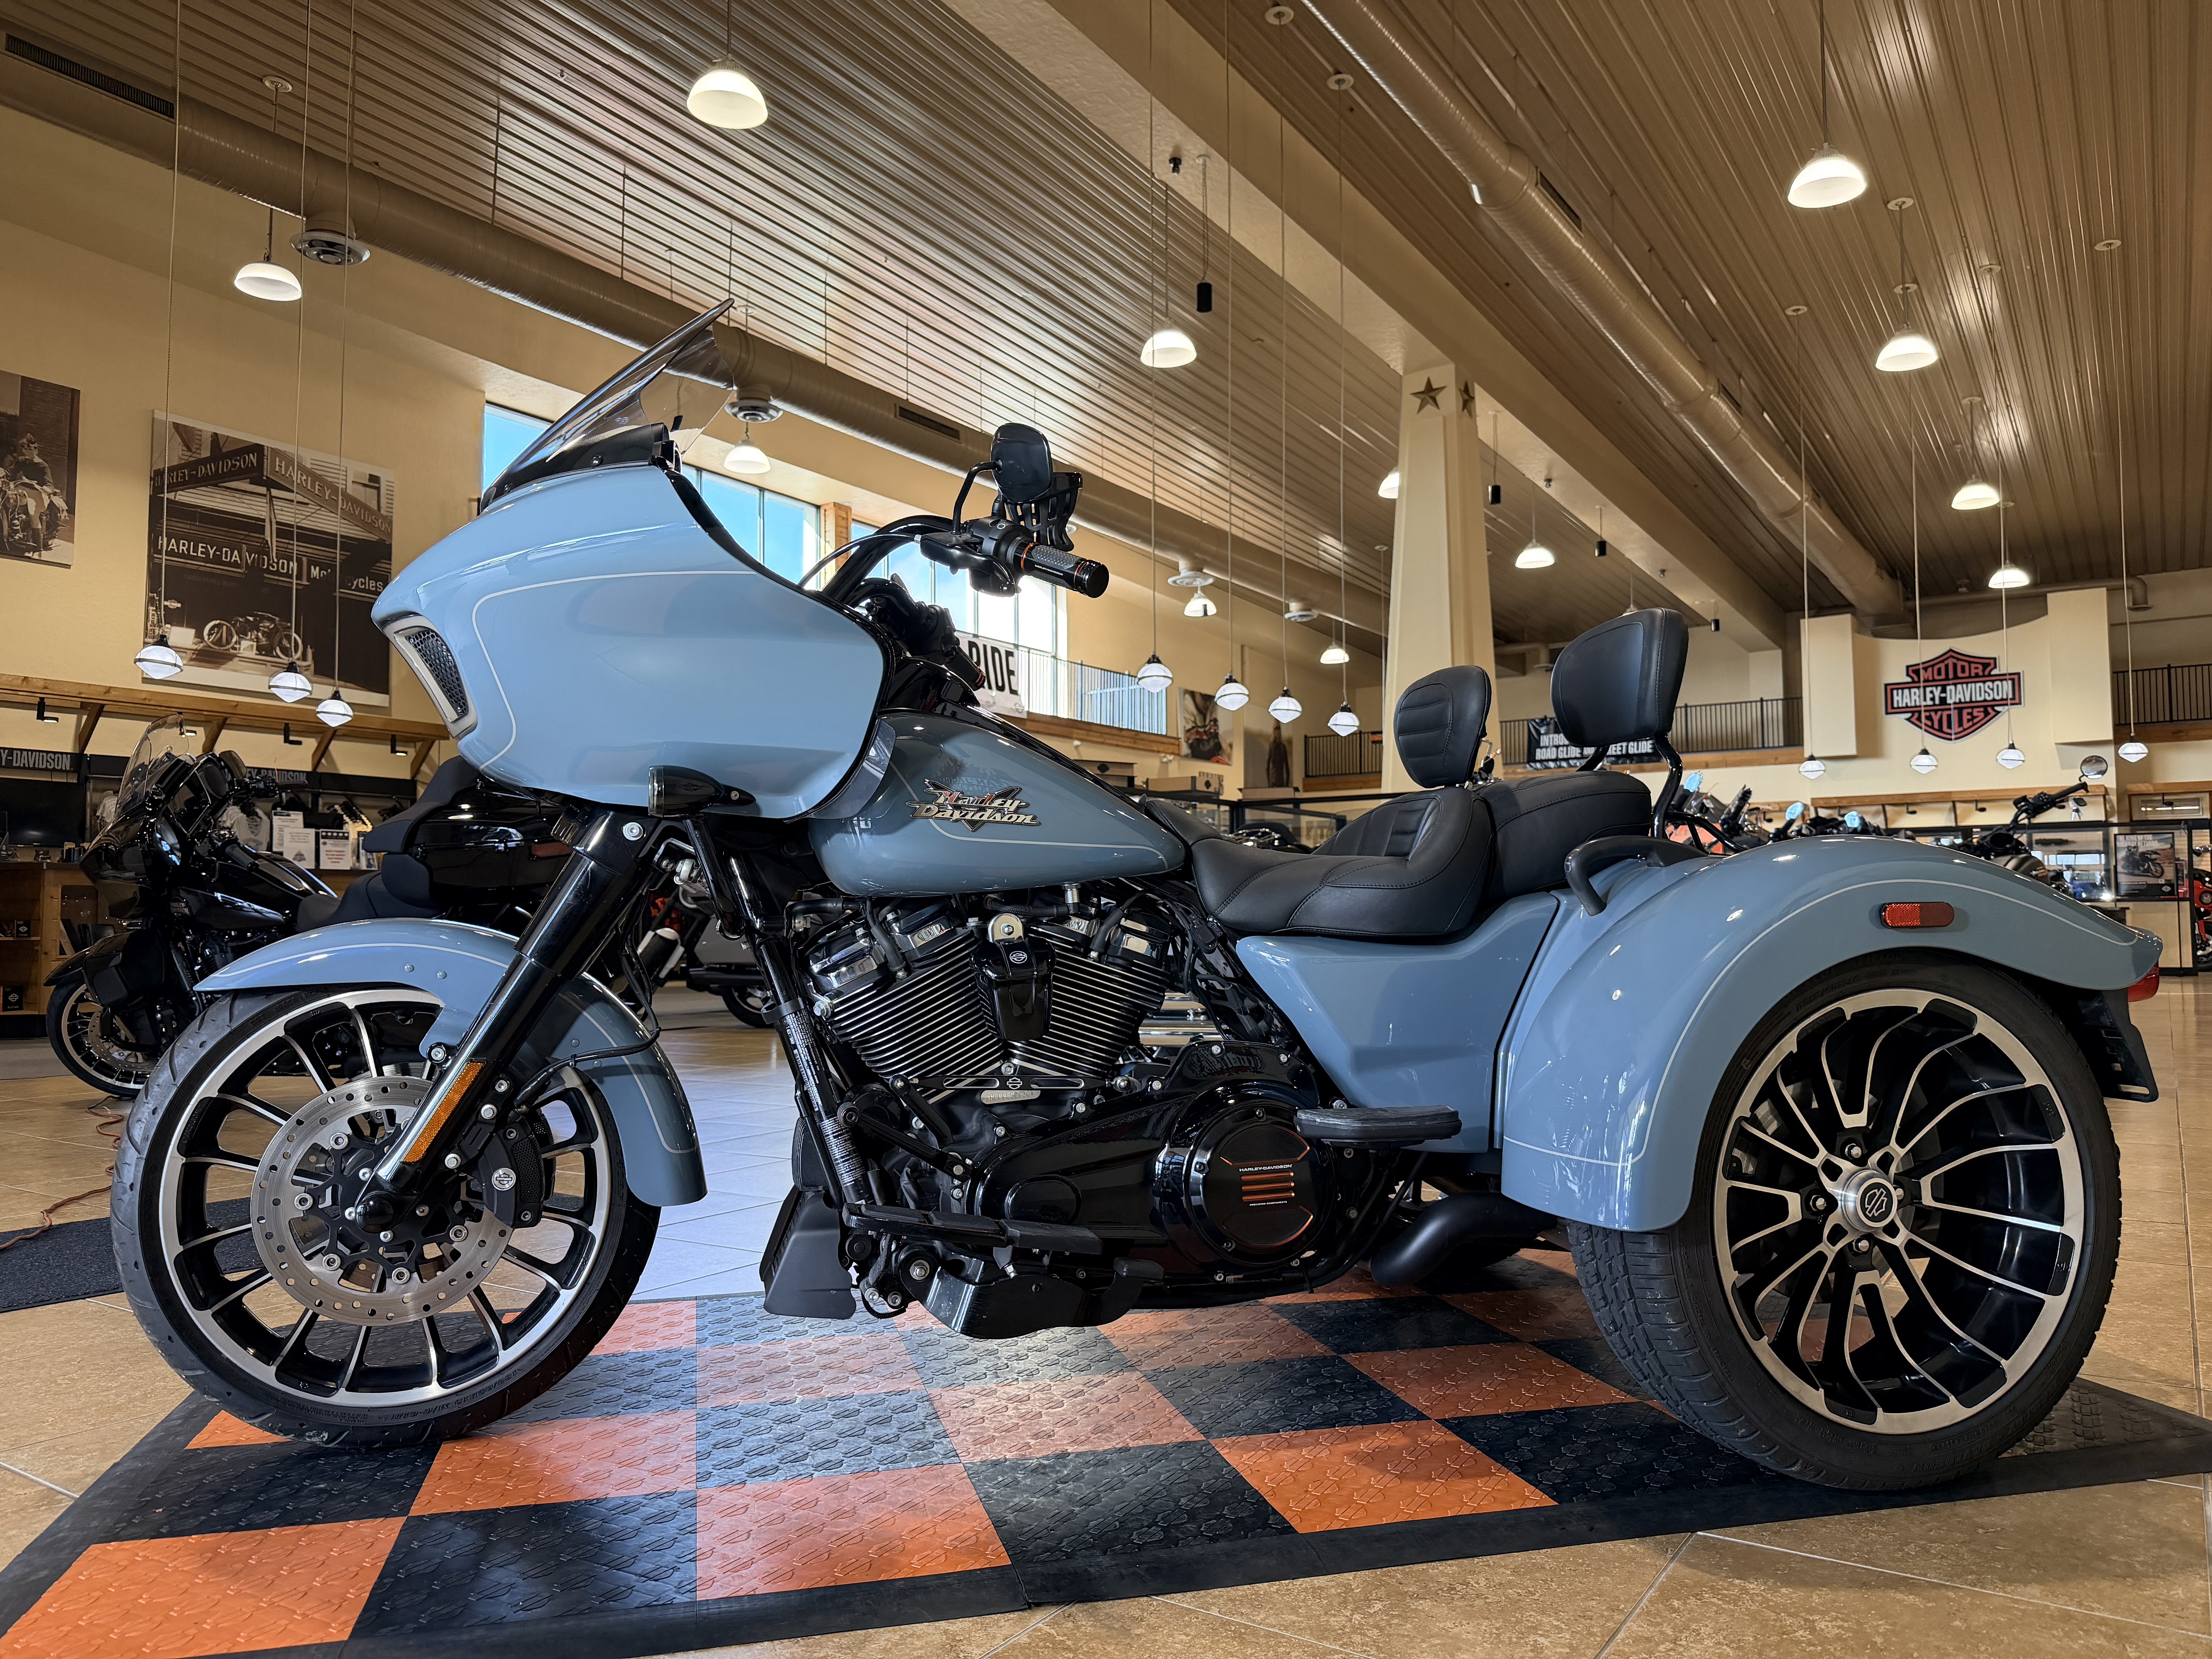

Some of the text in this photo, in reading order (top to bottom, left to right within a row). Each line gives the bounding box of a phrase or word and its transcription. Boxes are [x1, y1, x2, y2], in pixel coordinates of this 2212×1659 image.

[1921, 657, 1984, 681] MOTOR
[1892, 679, 2013, 708] HARLEY-DAVIDSON
[1923, 707, 1985, 733] CYCLES
[1535, 747, 1557, 761] ROAD
[1558, 745, 1582, 758] GLIDE
[1628, 739, 1654, 755] GLIDE
[907, 801, 1040, 823] Davidson
[1239, 1164, 1293, 1172] HARLEY-DAVIDSON
